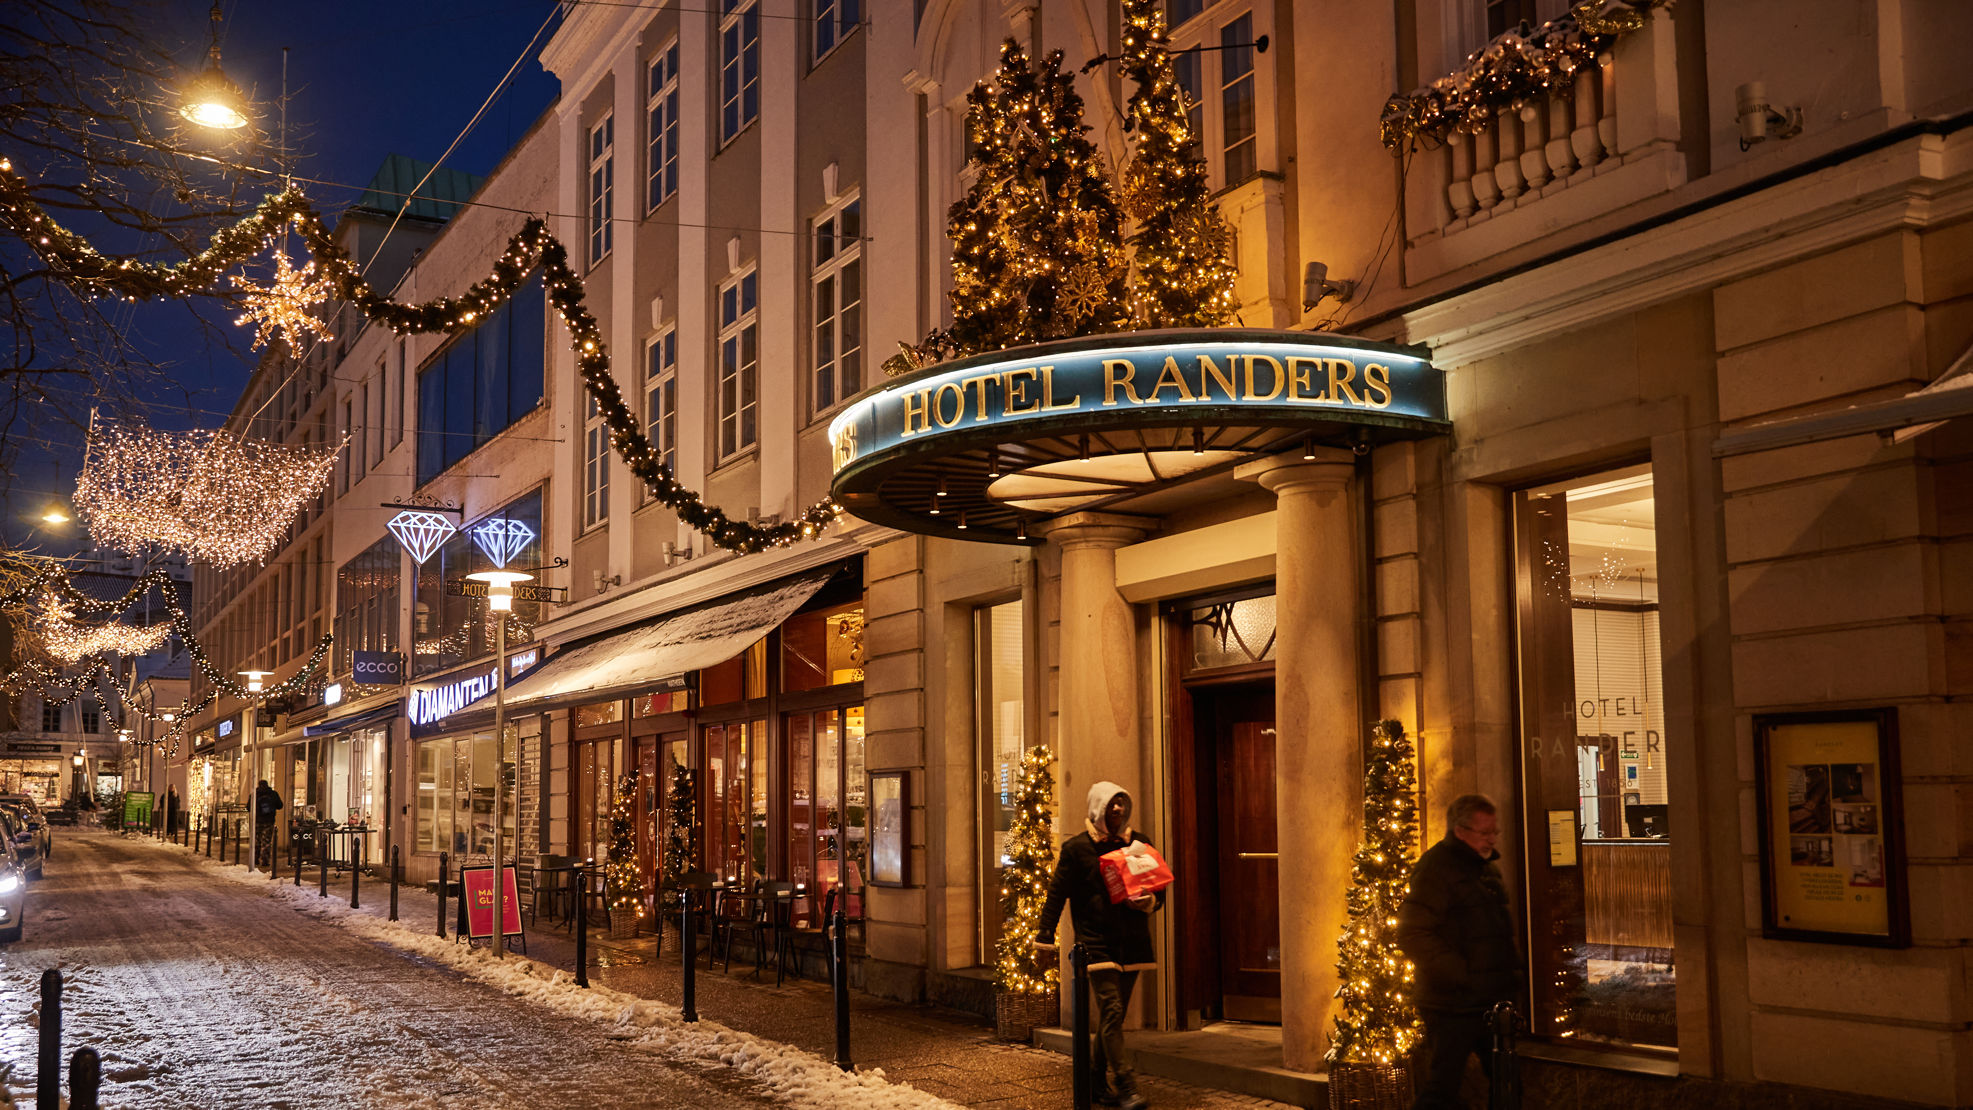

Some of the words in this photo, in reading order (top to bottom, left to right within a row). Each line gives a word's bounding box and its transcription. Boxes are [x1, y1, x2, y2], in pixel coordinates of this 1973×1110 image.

[901, 365, 1080, 437] HOTEL
[1102, 355, 1392, 408] RANDERS
[462, 583, 488, 597] HOTE
[514, 587, 537, 600] DERS
[356, 661, 398, 673] ecco
[420, 674, 489, 725] DIAMANTEN
[1563, 696, 1642, 720] HOTEL
[997, 748, 1016, 760] HOT
[1531, 730, 1660, 758] RANDER
